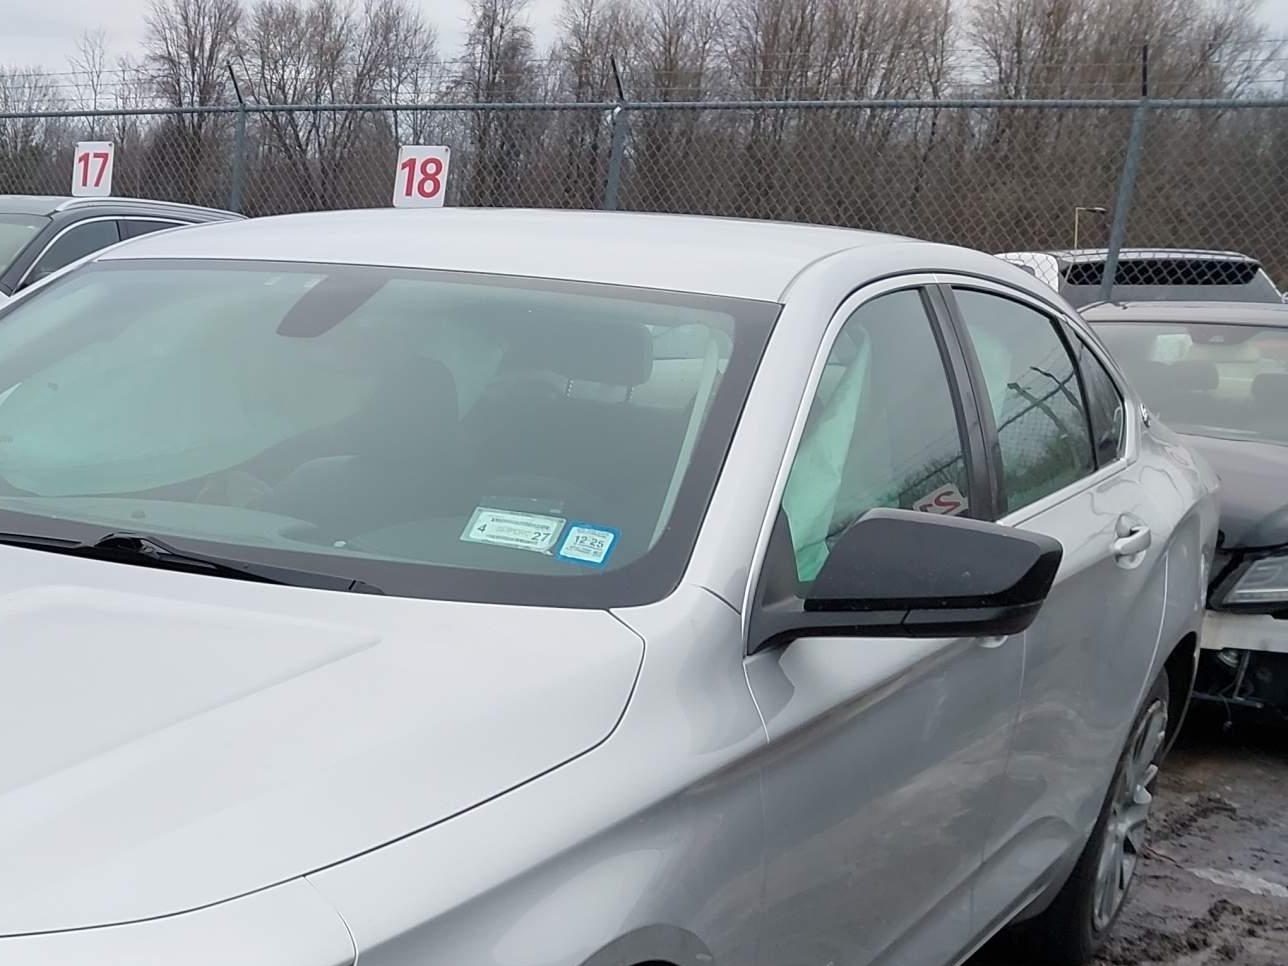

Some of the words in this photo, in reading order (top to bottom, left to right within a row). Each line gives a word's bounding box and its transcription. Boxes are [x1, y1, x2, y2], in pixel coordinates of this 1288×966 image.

[77, 152, 110, 188] 17
[400, 157, 444, 199] 18
[531, 531, 551, 542] 27
